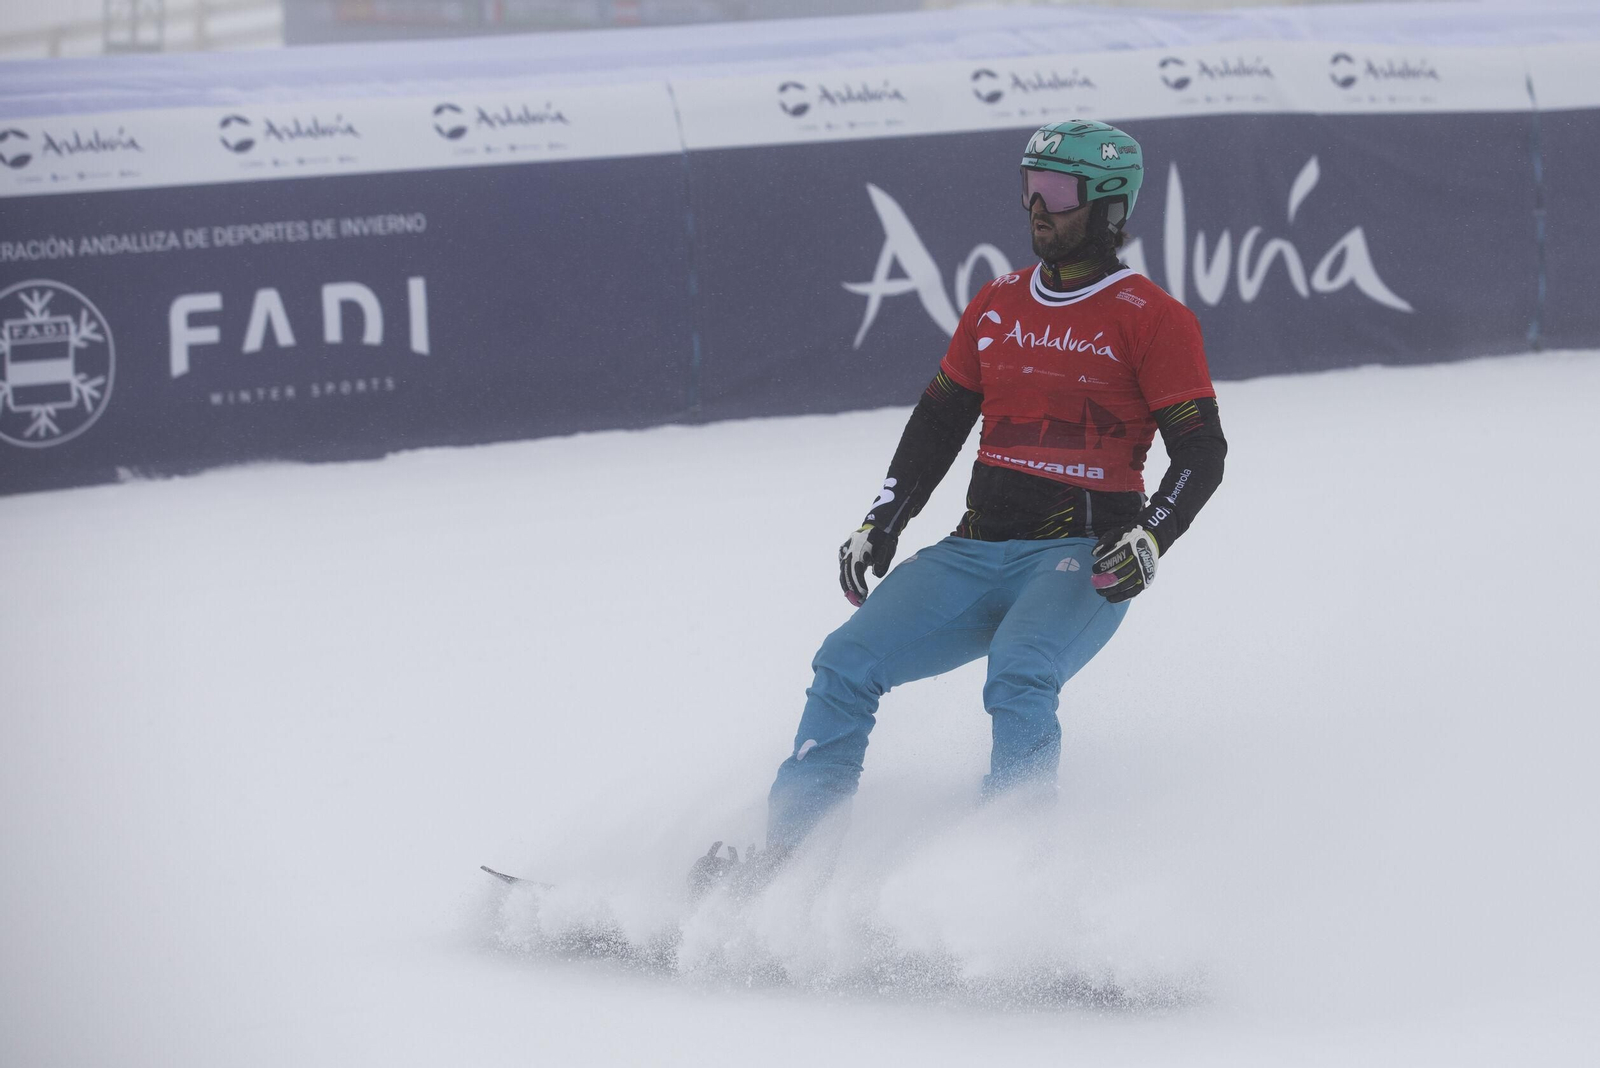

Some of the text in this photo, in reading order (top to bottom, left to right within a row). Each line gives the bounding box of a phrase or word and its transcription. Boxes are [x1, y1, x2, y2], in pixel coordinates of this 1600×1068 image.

[0, 212, 426, 262] RACIÓN ANDALUZA DE DEPORTES DE INVIERNO
[169, 276, 430, 379] FADI
[1002, 319, 1121, 362] Andalucía
[210, 376, 396, 406] WINTER SPORTS
[1100, 549, 1127, 571] SWANY
